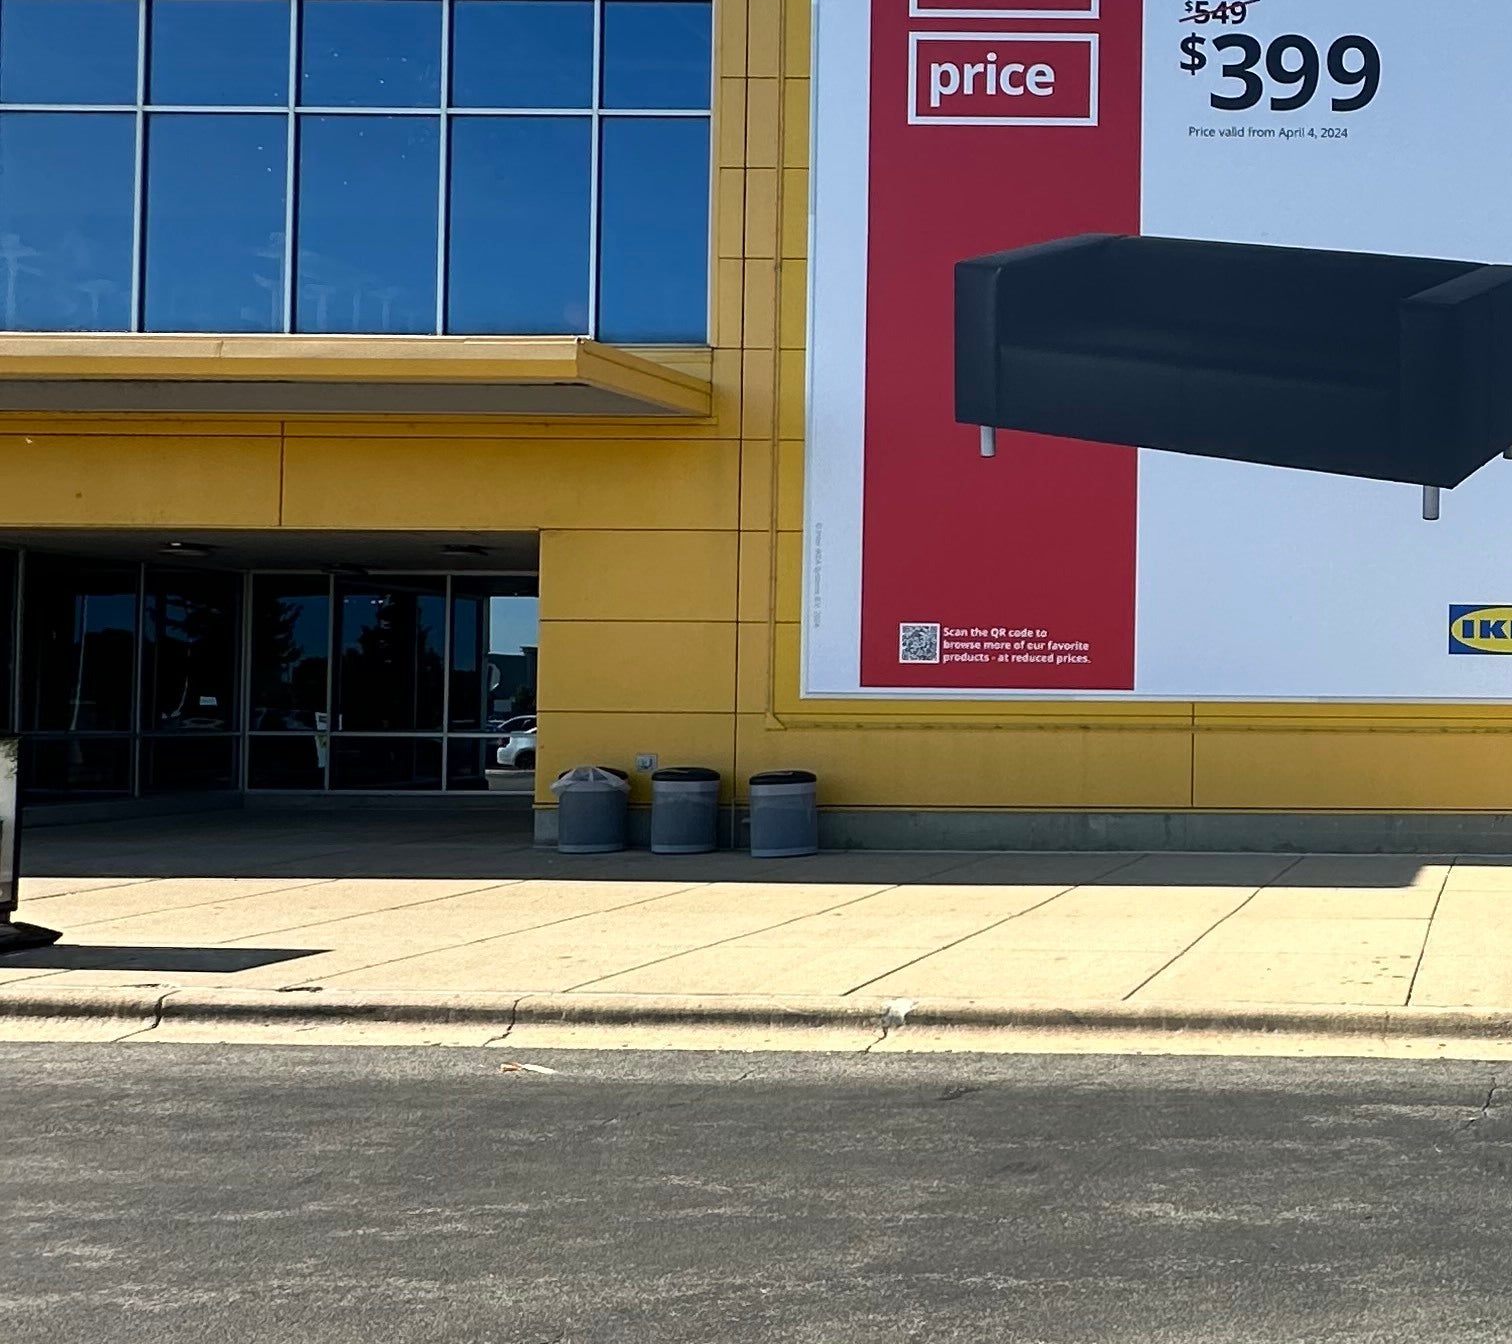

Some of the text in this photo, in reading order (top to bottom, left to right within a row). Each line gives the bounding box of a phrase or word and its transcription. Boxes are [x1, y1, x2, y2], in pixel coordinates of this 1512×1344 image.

[1184, 0, 1248, 25] $549
[1180, 32, 1381, 112] $399
[930, 52, 1055, 108] price
[1188, 126, 1348, 140] Price valid from April 4, 2024
[943, 627, 1048, 638] Scan the QR code to
[943, 640, 1089, 651] browse more of our favorite
[943, 653, 990, 664] products
[998, 654, 1009, 663] at
[1011, 653, 1055, 663] reduced
[1056, 654, 1092, 665] prices.
